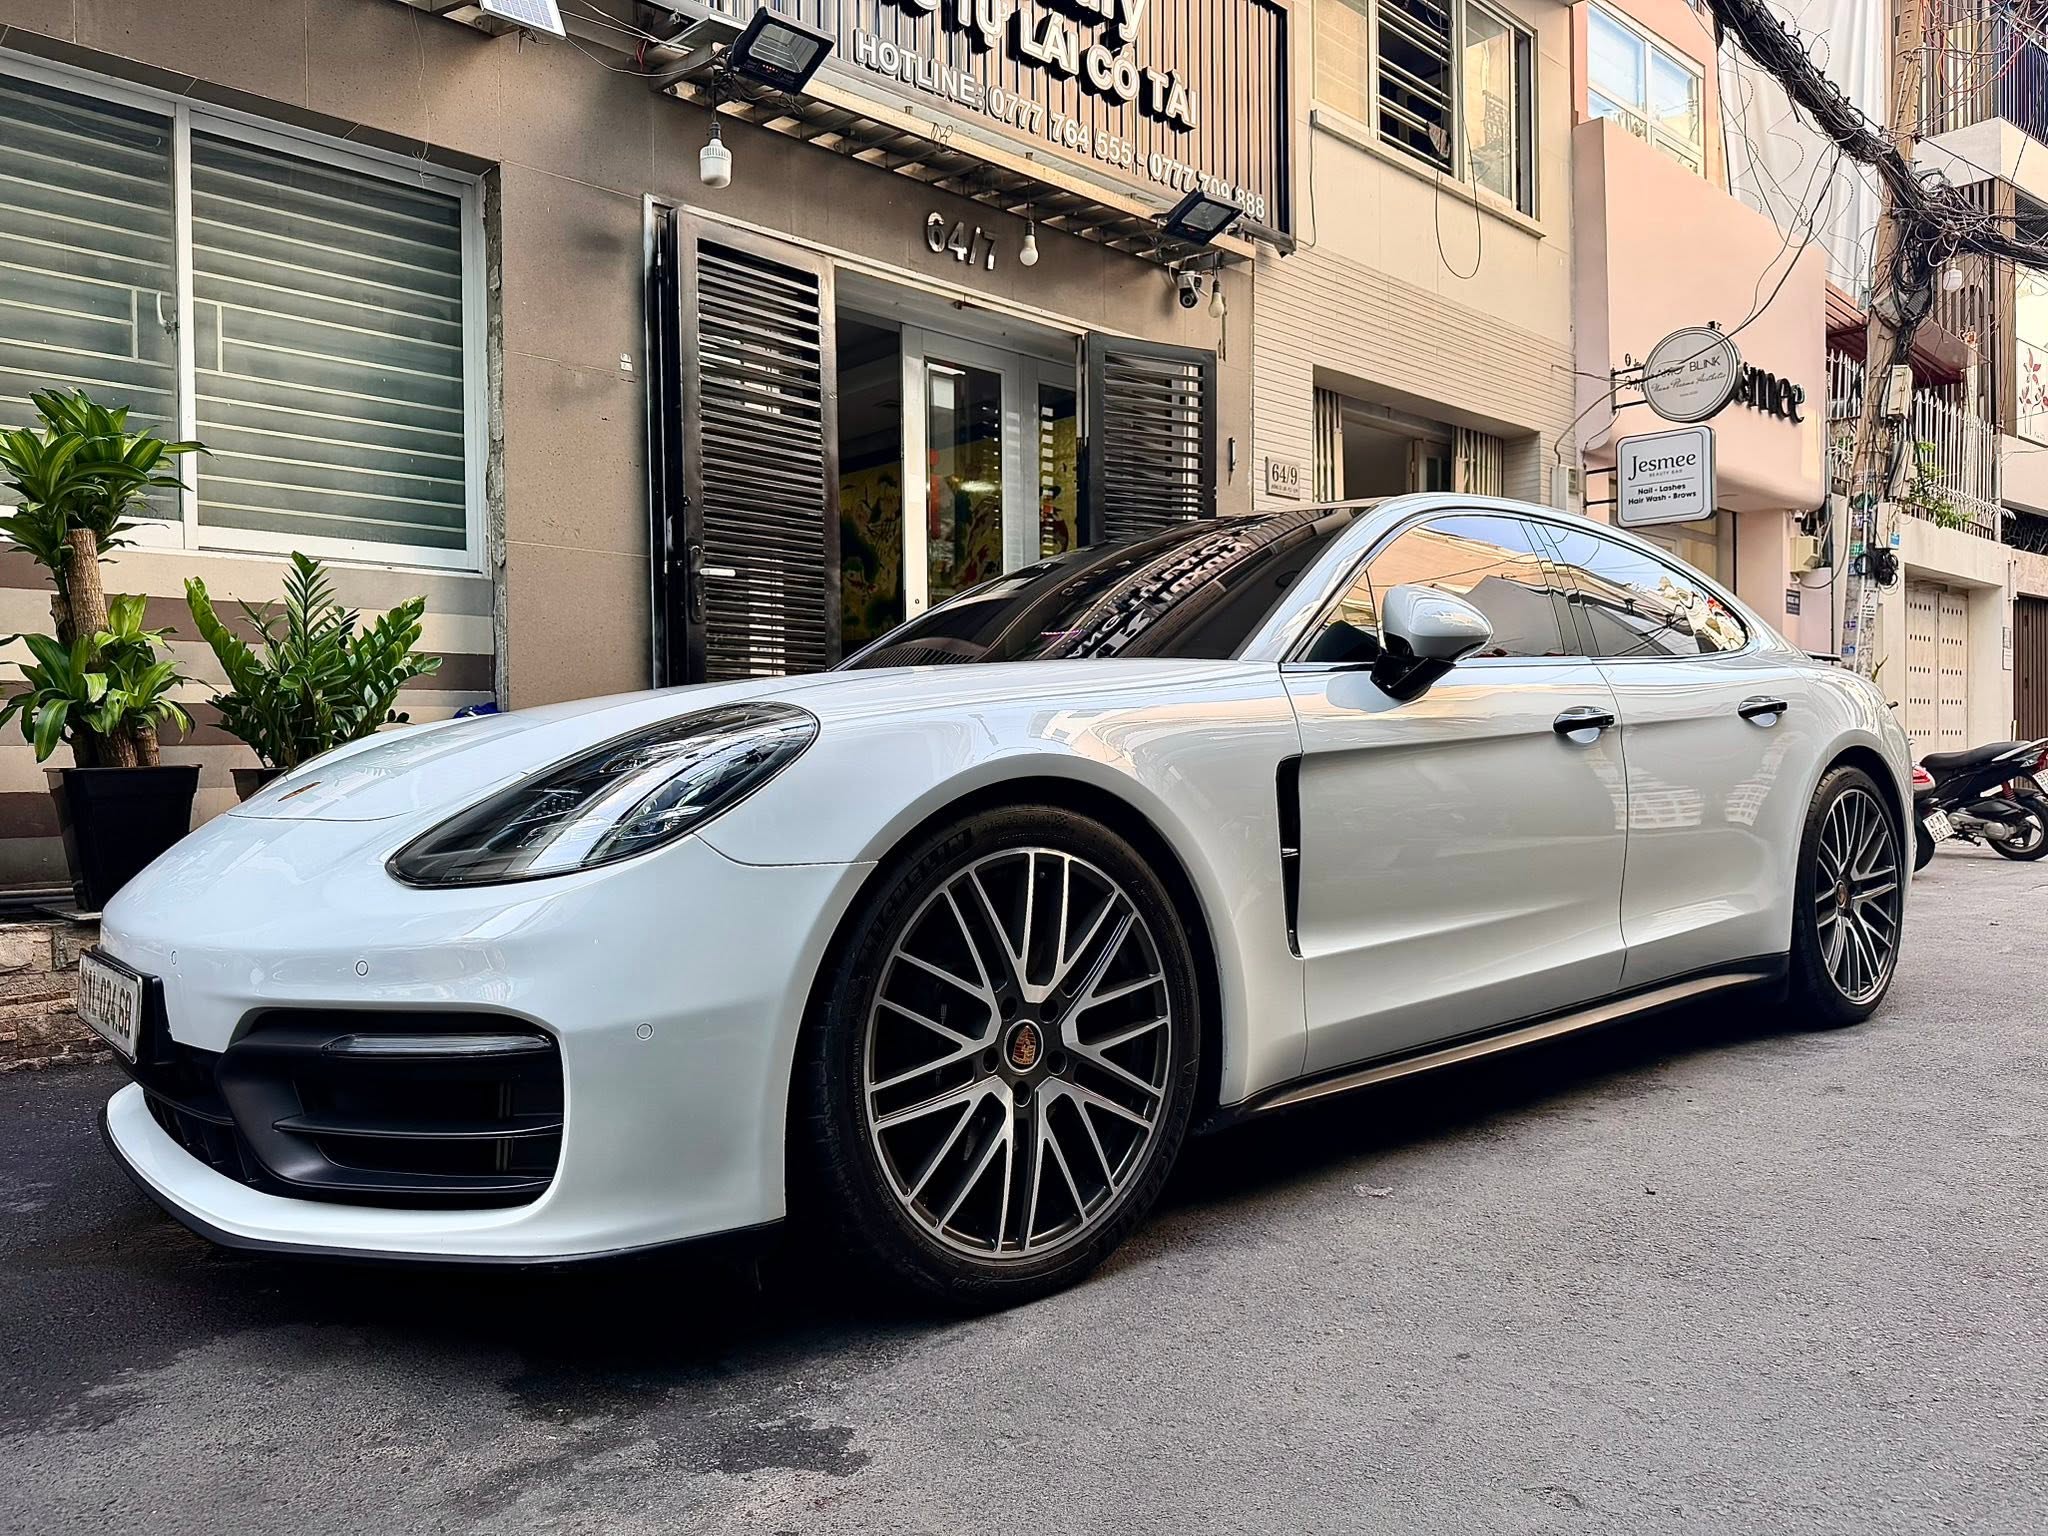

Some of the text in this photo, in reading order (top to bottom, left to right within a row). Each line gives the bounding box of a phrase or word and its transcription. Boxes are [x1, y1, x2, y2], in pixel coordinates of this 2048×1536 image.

[1020, 8, 1079, 75] LÁI
[1087, 43, 1140, 101] CÓ
[1147, 66, 1197, 128] TÀI
[854, 26, 985, 112] HOTLINE:
[988, 86, 1043, 134] 0777
[1050, 110, 1090, 152] 764
[1094, 130, 1132, 167] 555
[1149, 152, 1194, 193] 0777
[1235, 186, 1265, 220] 888
[927, 211, 1000, 271] 64/7
[1689, 356, 1720, 372] BLINK
[1272, 463, 1298, 485] 64/9
[1627, 453, 1696, 481] Jesmee
[1638, 487, 1653, 495] Nail
[1659, 484, 1686, 492] Lashes
[1645, 495, 1667, 503] Wash
[1673, 491, 1697, 499] Brows
